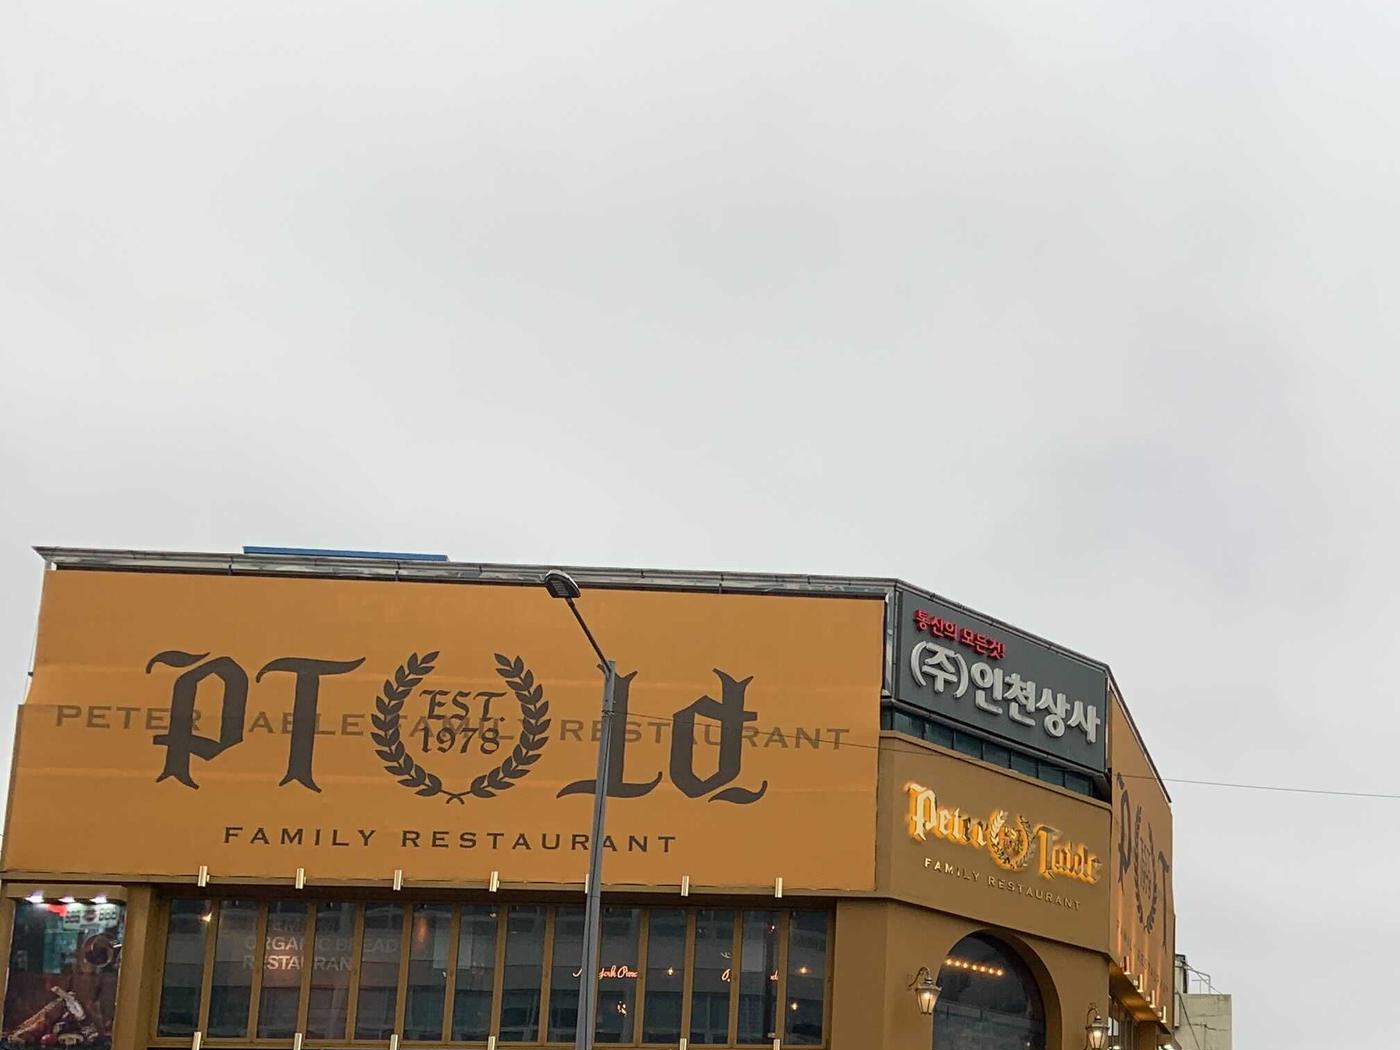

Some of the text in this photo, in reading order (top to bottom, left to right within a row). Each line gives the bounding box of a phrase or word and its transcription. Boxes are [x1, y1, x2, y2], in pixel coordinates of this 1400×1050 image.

[910, 641, 1101, 744] (주)인천상사
[248, 711, 365, 736] ABLE
[420, 725, 501, 755] 1978
[906, 782, 987, 847] Peter
[223, 826, 677, 853] FAMILY RESTAURANT
[924, 857, 1081, 911] FAMILY RESTAURANT
[336, 937, 398, 954] BEAD
[243, 955, 351, 972] RESTARAN
